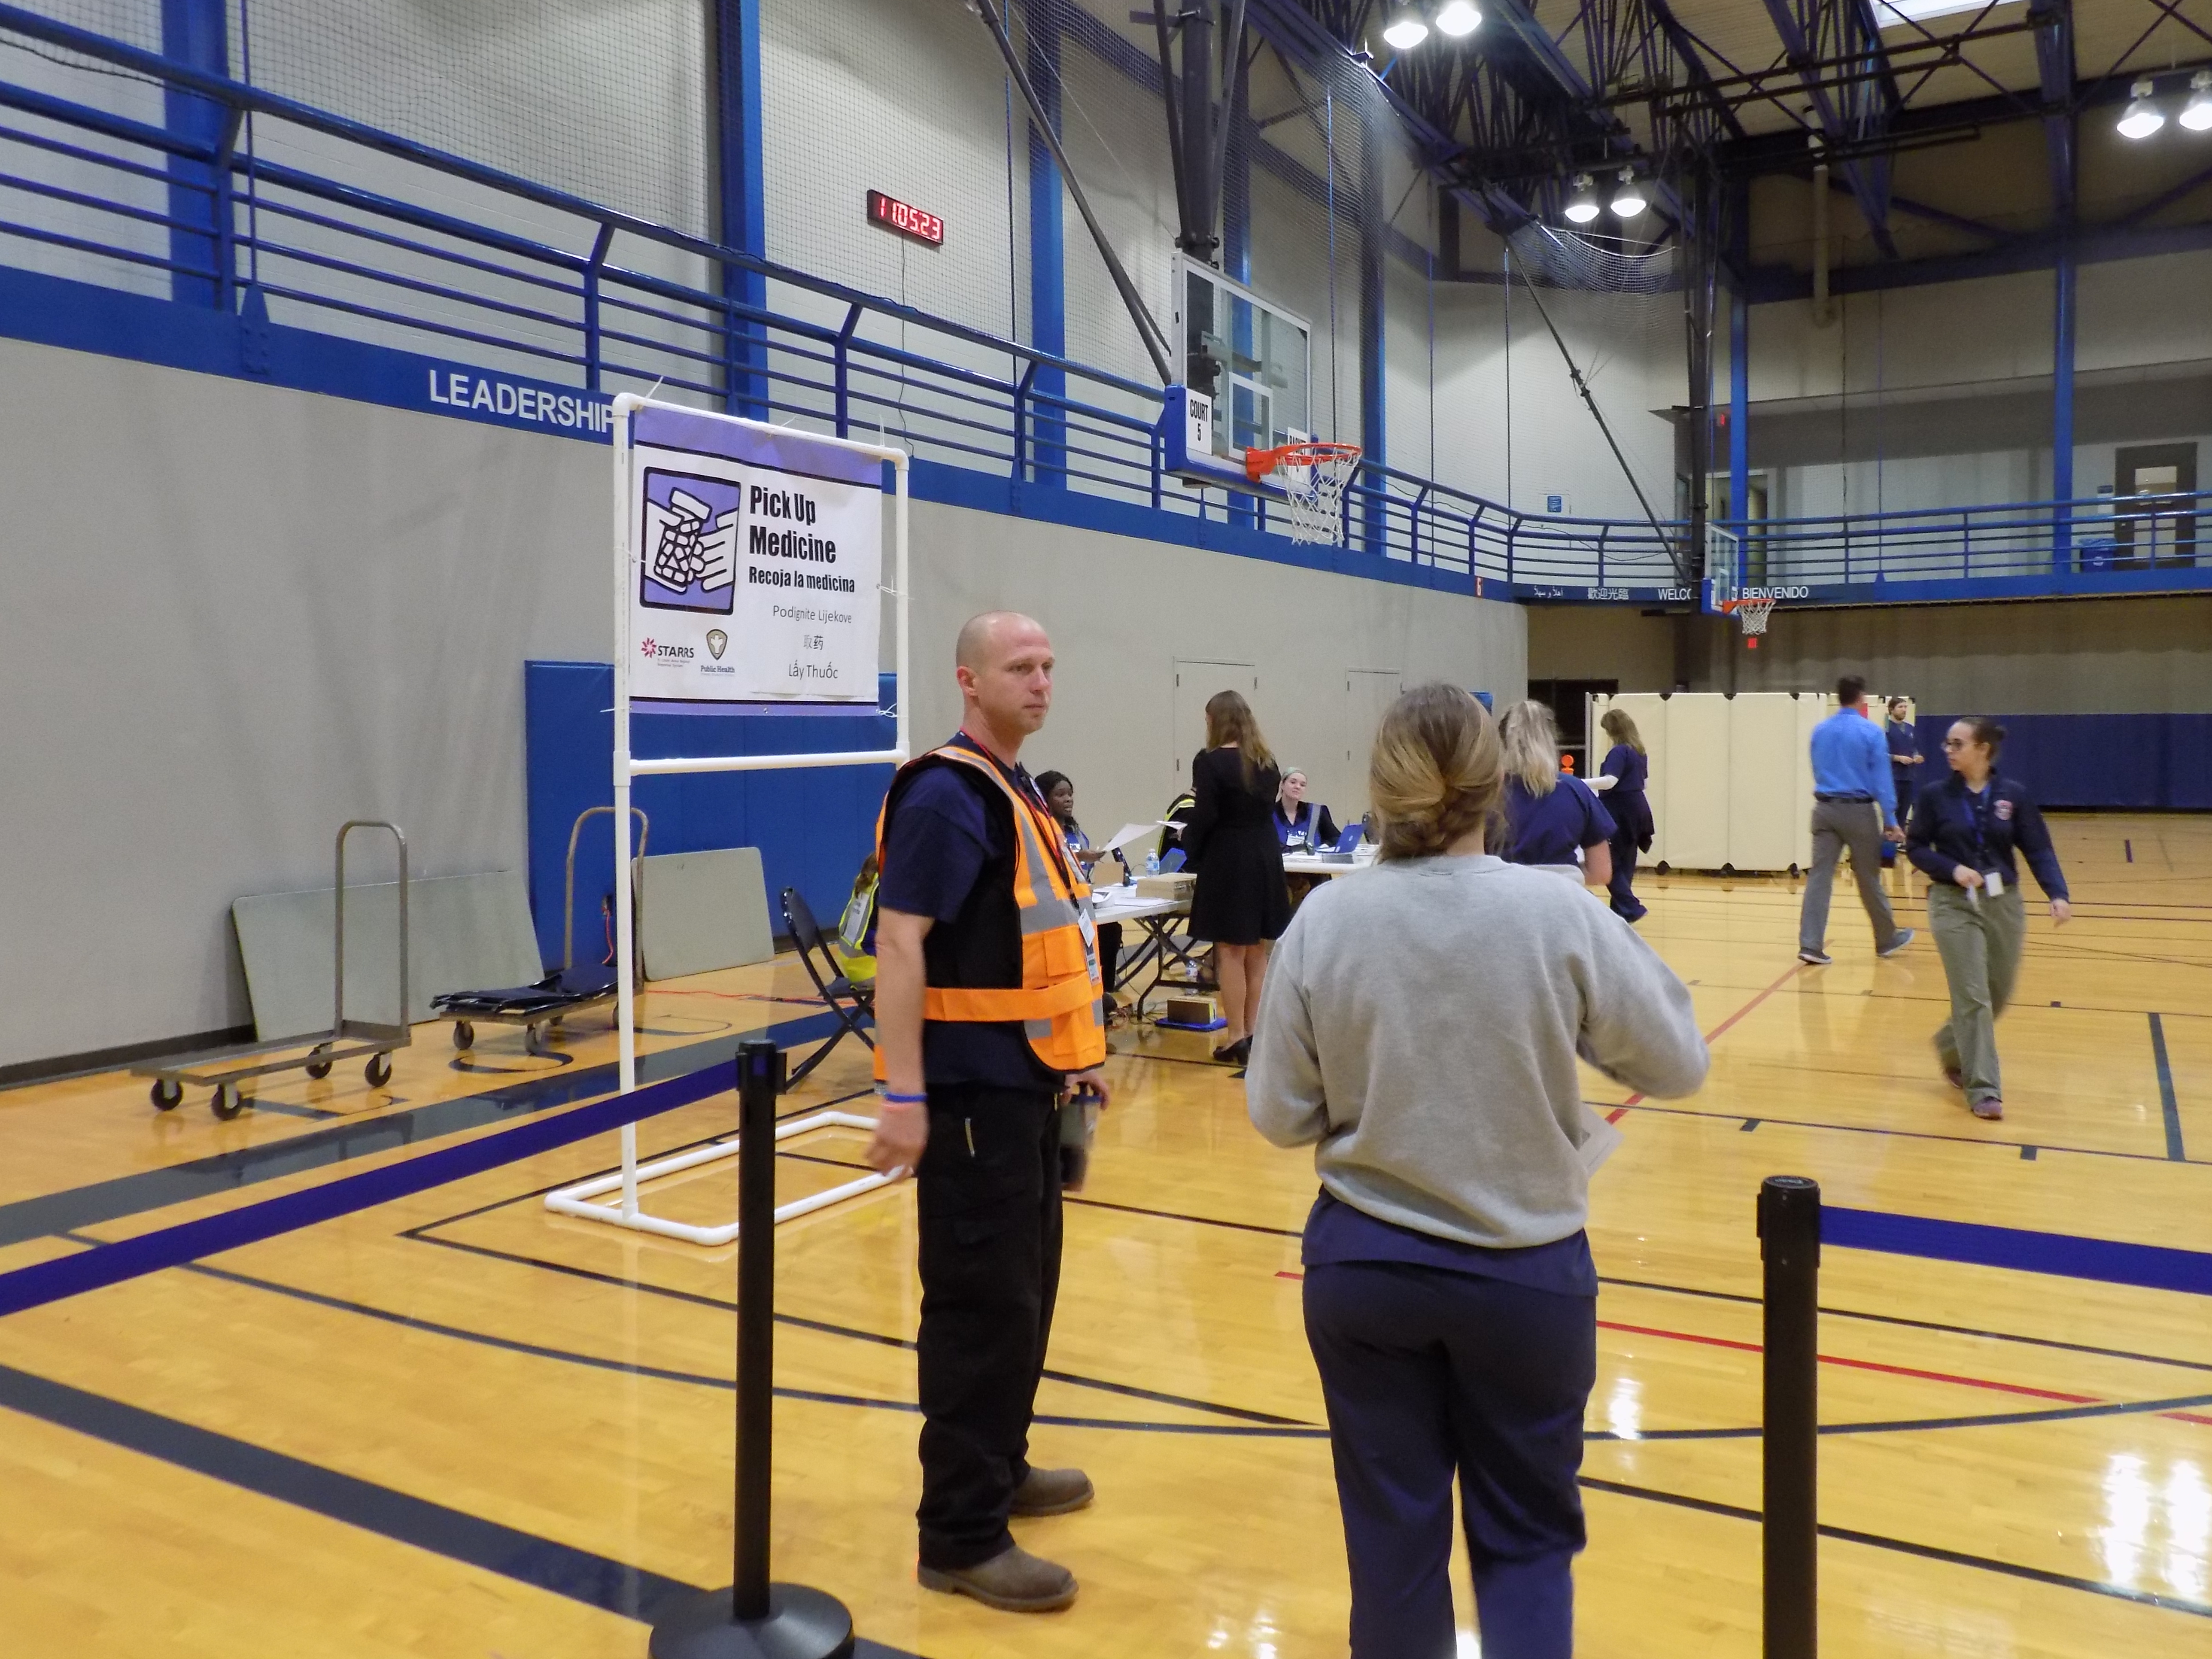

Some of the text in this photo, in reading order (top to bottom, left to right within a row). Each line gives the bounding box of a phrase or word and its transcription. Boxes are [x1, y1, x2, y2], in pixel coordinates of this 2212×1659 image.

[430, 369, 614, 433] LEADERSHIP
[1190, 398, 1209, 422] COURT
[1197, 423, 1202, 442] 5
[750, 485, 816, 526] Pick Up
[749, 525, 836, 564] Medicine
[749, 566, 855, 593] Recoja la medicina
[1477, 577, 1482, 596] 6
[1588, 587, 1629, 600] 歡迎光臨
[1742, 586, 1808, 599] BIENVENIDO
[772, 605, 852, 624] Podignite Lijekove
[657, 645, 695, 658] STARRS
[803, 635, 824, 650] 取药
[717, 665, 735, 674] Health
[789, 659, 804, 681] Lấy
